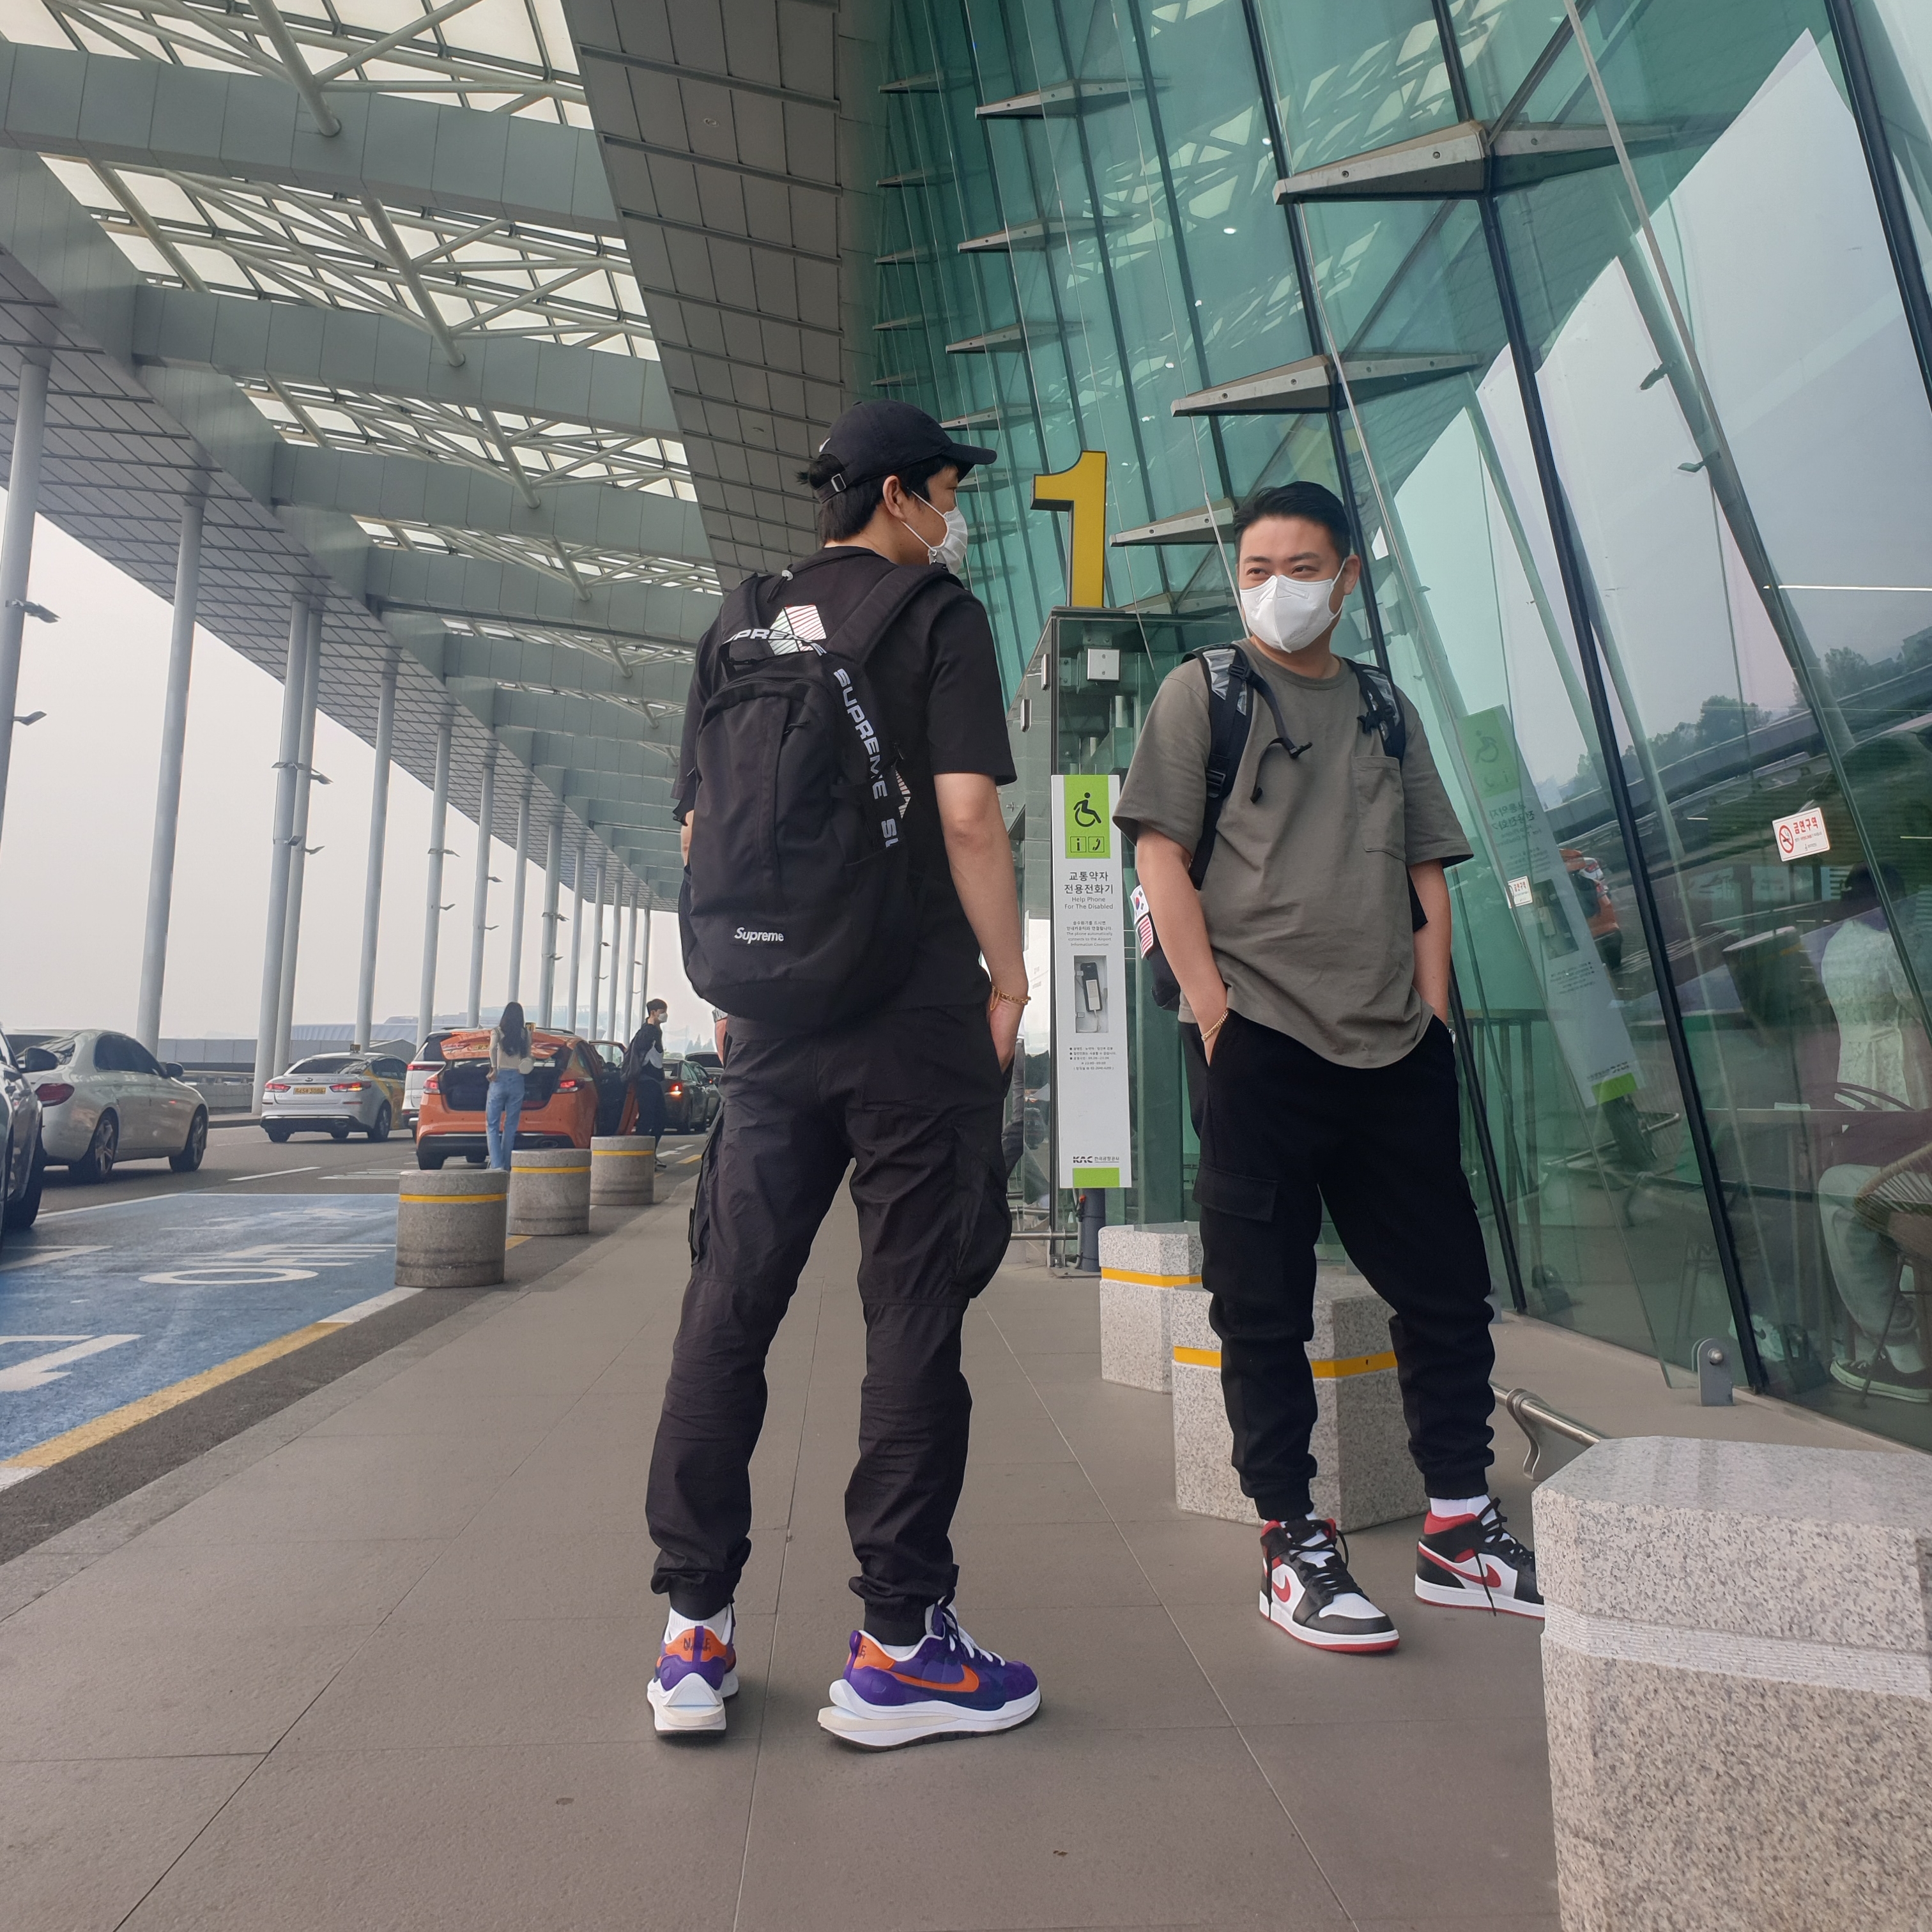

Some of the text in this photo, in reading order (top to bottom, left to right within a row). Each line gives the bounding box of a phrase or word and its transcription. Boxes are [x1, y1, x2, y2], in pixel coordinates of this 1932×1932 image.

[1031, 450, 1107, 607] 1
[834, 668, 888, 799] SUPREME
[1793, 816, 1819, 834] 금연구역
[1069, 871, 1108, 881] 교통약자
[1064, 884, 1113, 894] 전용전화기
[734, 927, 785, 944] Supreme
